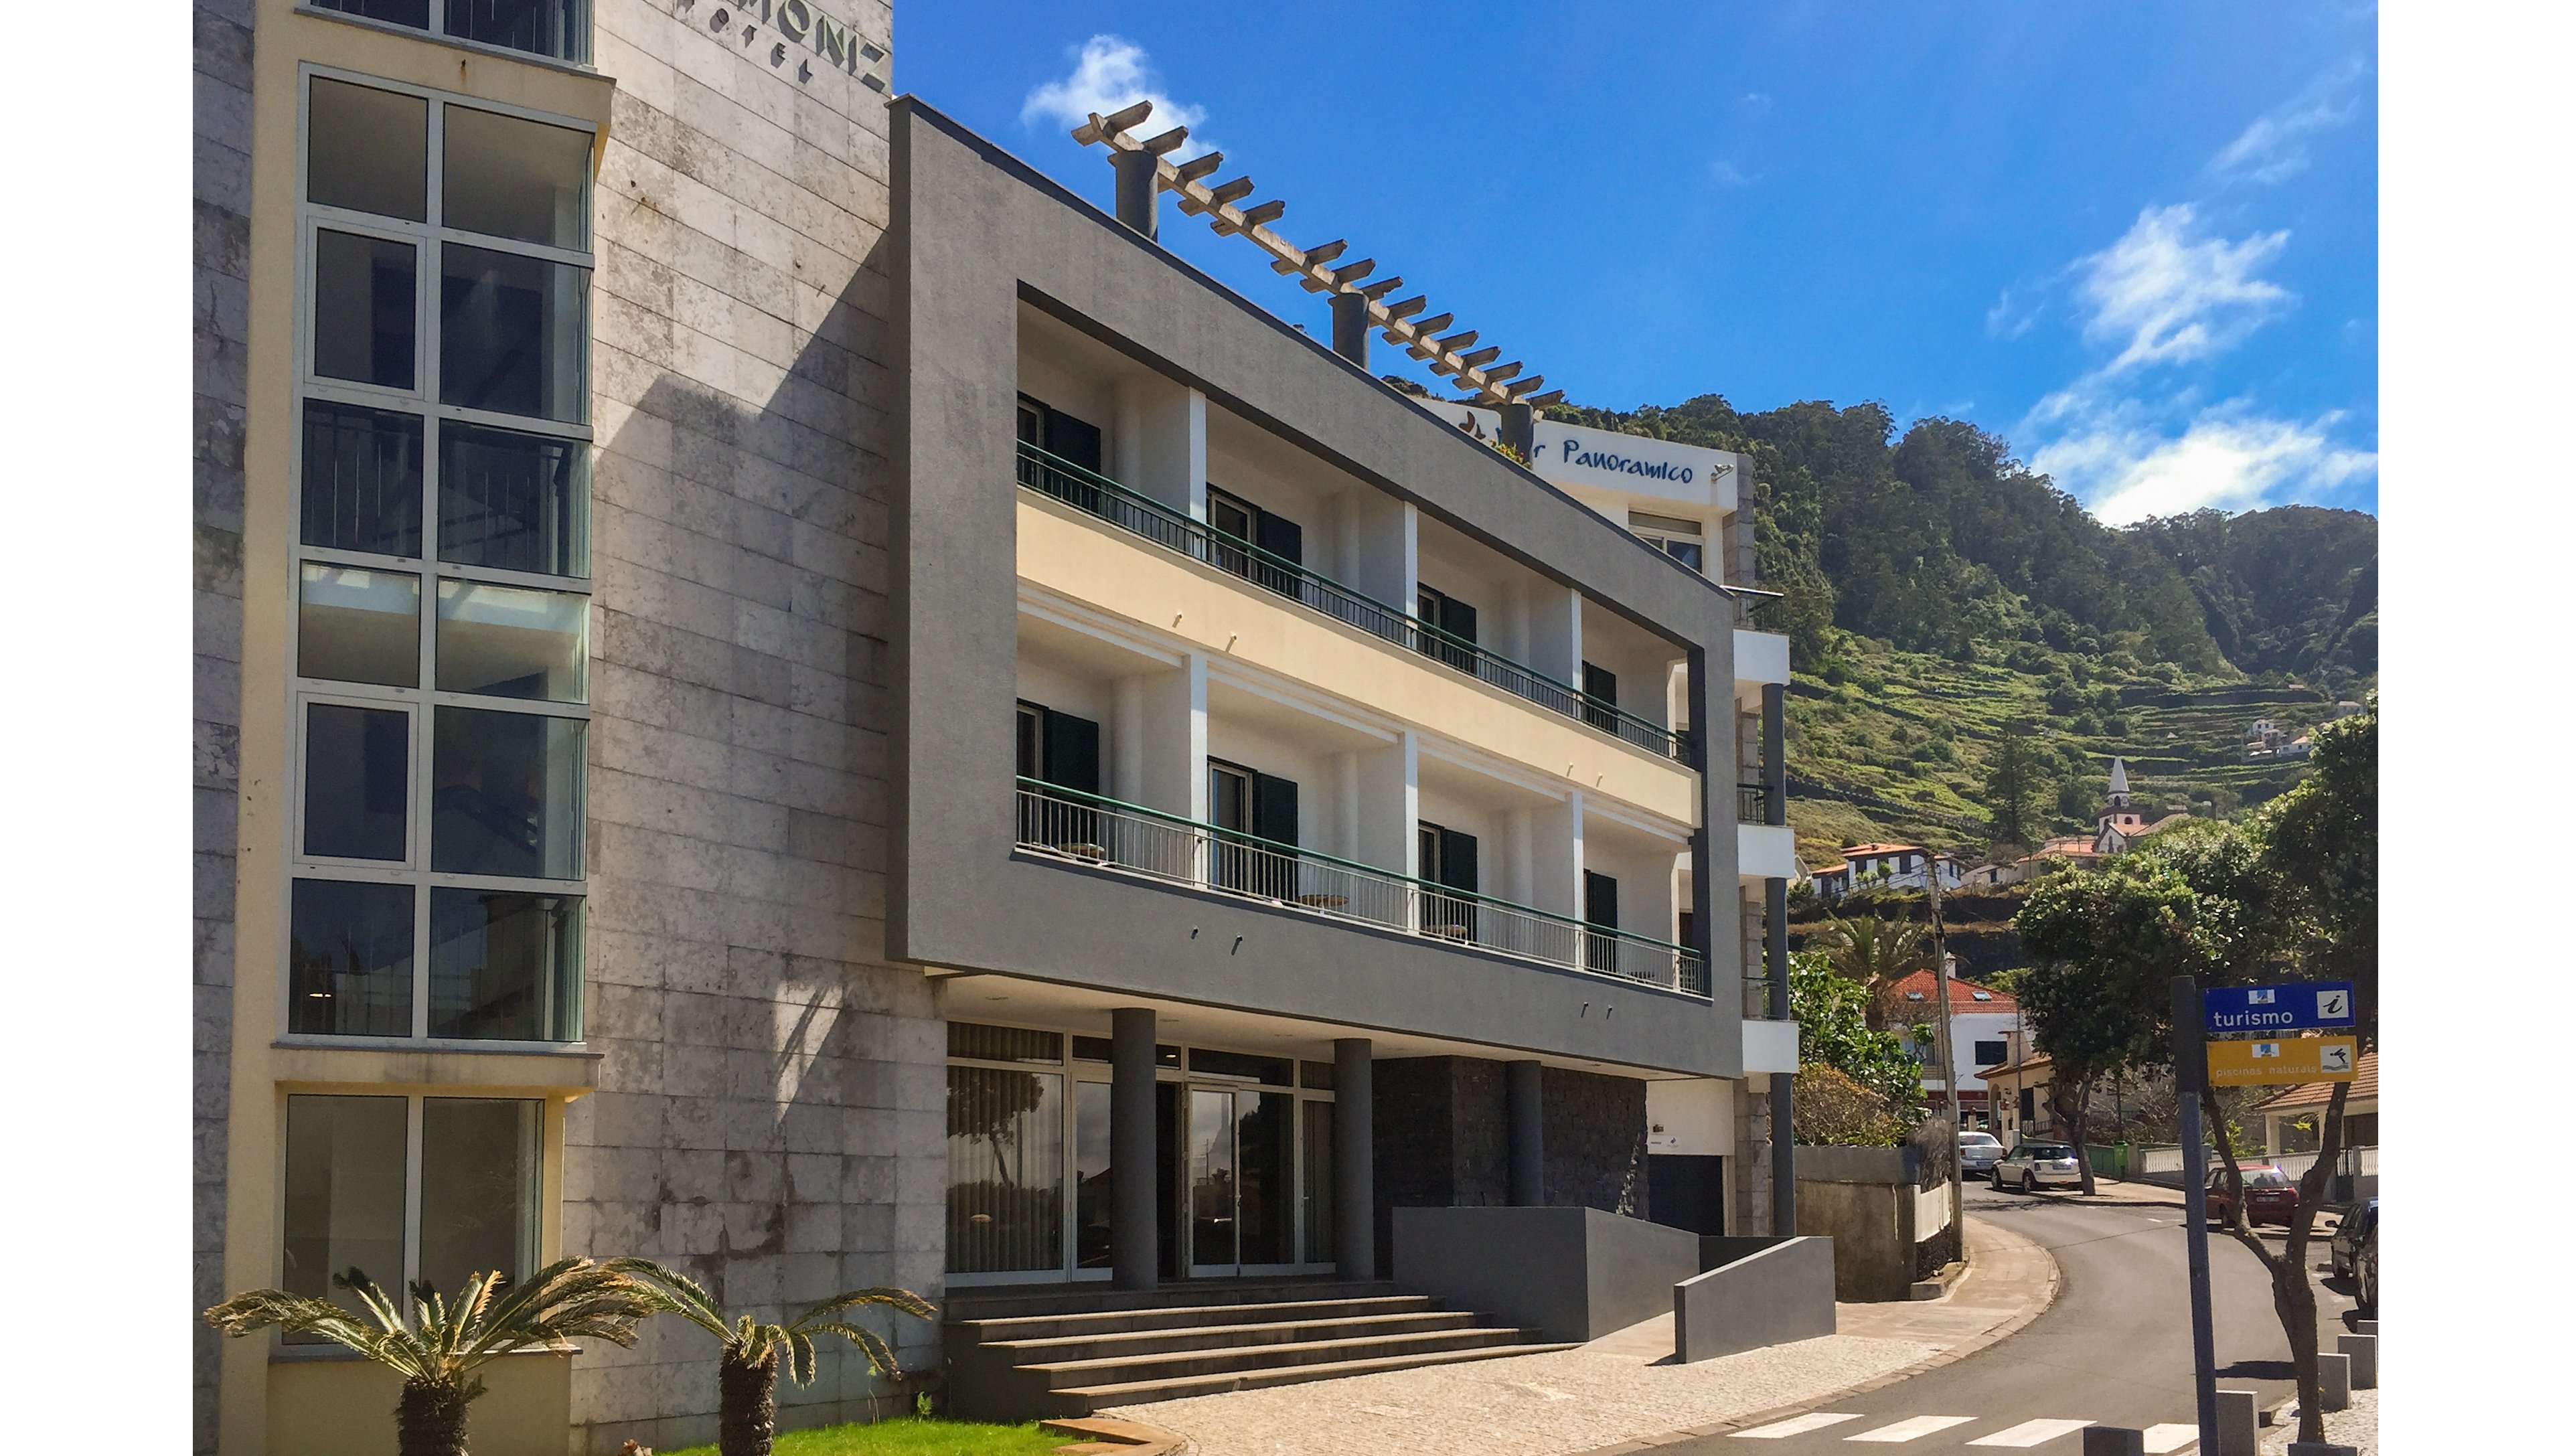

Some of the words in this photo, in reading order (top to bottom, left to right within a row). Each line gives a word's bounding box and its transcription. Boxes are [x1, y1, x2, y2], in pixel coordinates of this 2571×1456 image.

[1563, 439, 1693, 484] Panoramico
[2213, 1009, 2294, 1027] turismo
[2215, 1068, 2262, 1078] piscinas
[2268, 1065, 2317, 1075] naturais
